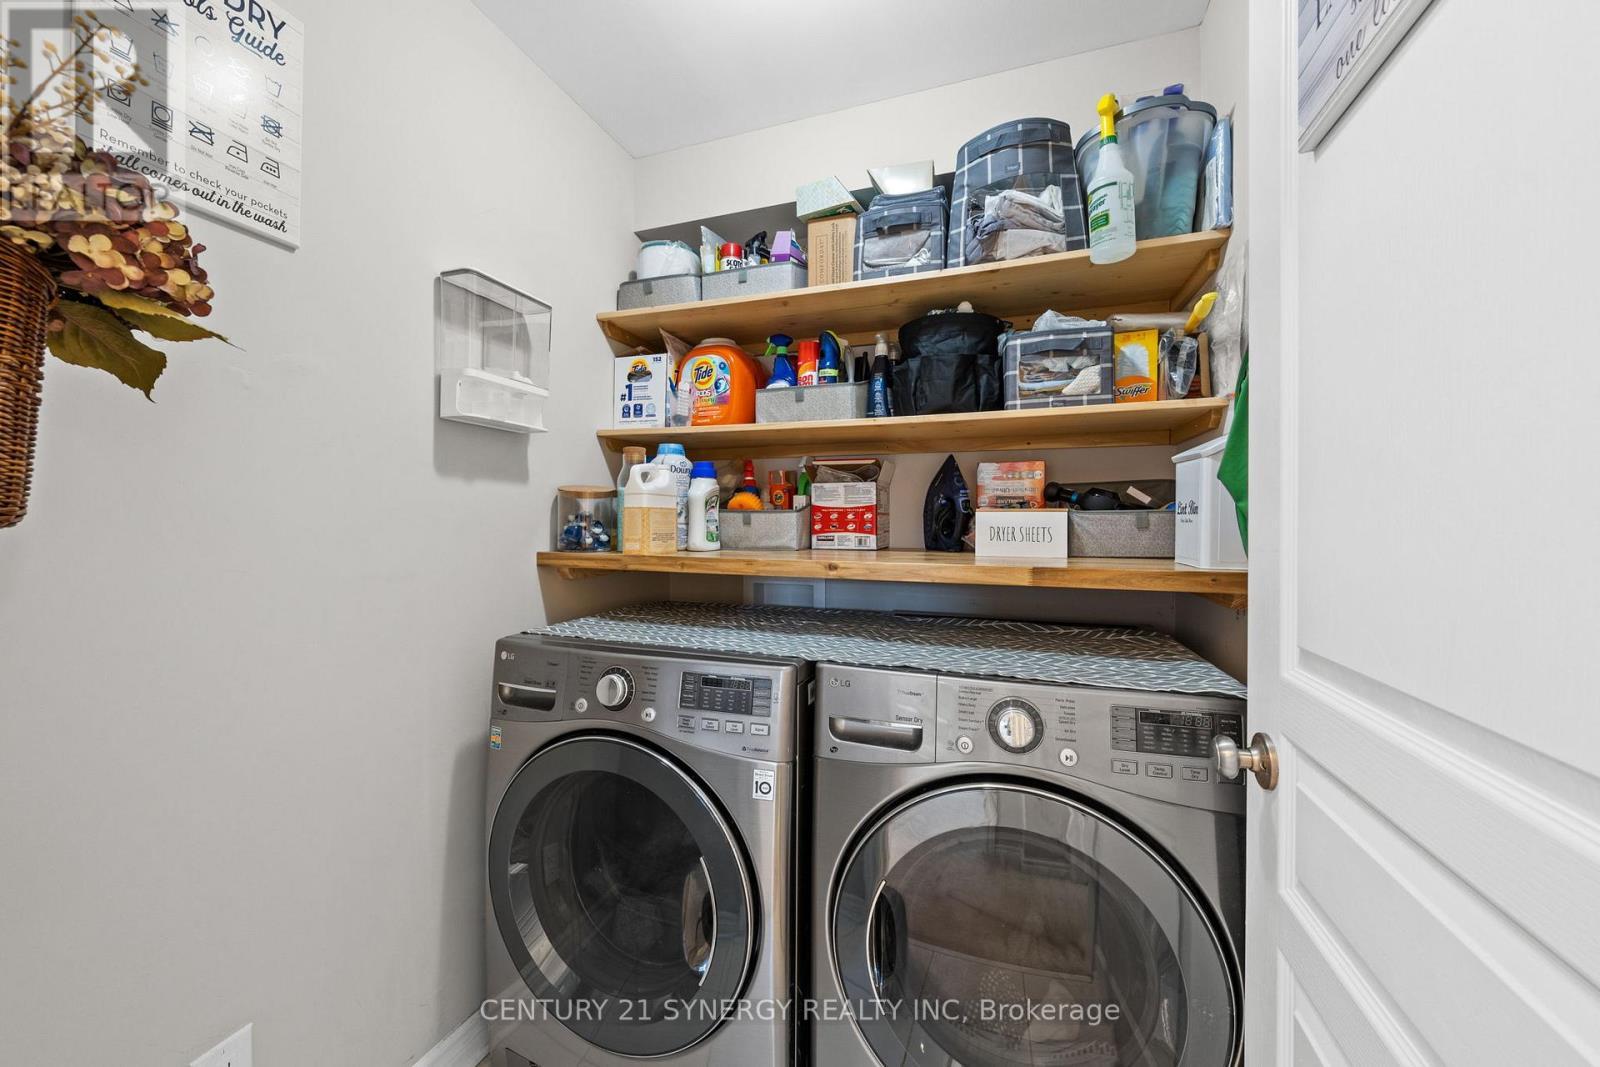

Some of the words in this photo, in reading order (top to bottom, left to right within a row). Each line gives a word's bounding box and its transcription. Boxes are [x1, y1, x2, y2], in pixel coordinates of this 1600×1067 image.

[226, 11, 286, 66] Guide
[100, 128, 169, 167] Remember
[174, 162, 186, 175] to
[189, 170, 222, 190] check
[224, 187, 248, 202] your
[251, 198, 288, 220] pockets
[115, 154, 141, 171] all
[141, 166, 190, 192] comes
[192, 187, 216, 203] out
[216, 195, 231, 210] in
[232, 200, 252, 219] the
[253, 213, 288, 233] wash
[694, 364, 714, 384] Tide
[989, 526, 1017, 542] DRYER
[1019, 526, 1053, 543] SHEETS
[914, 717, 923, 725] Dry
[755, 780, 772, 795] 10
